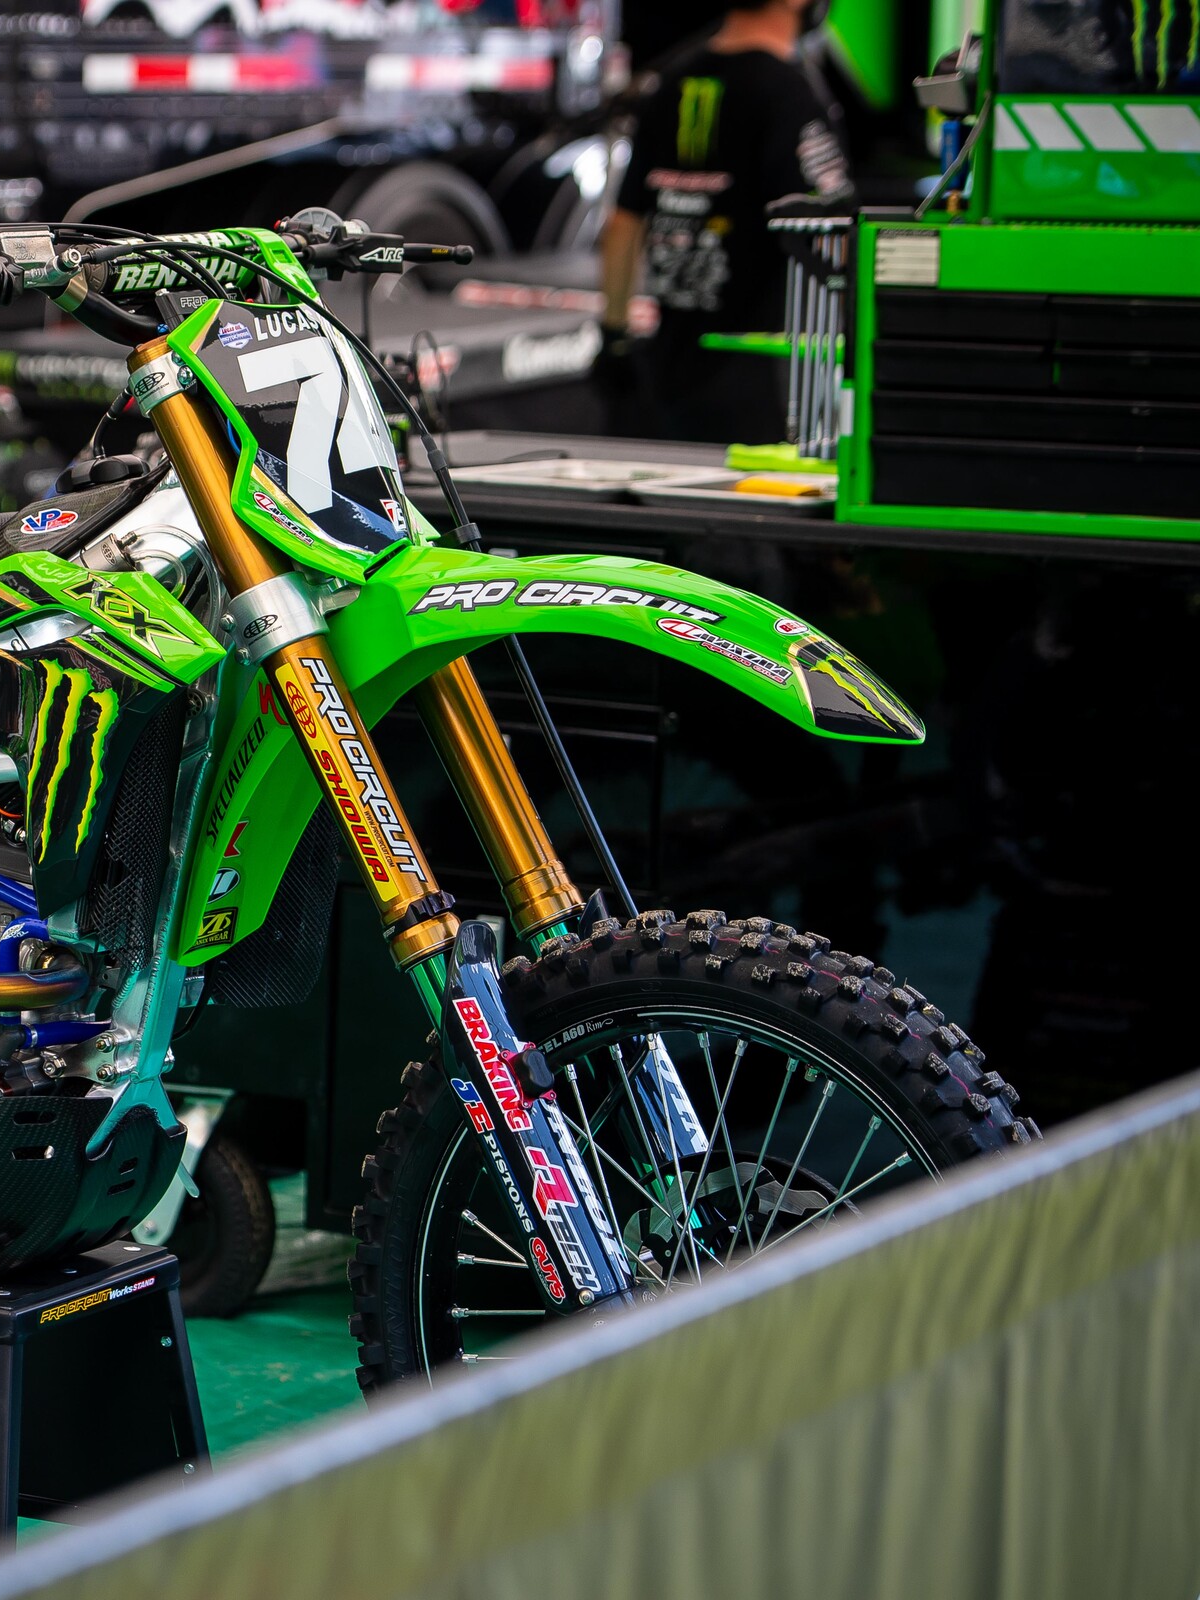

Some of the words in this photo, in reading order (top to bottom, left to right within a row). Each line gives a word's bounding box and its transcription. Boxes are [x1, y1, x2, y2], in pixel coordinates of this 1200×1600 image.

[359, 246, 404, 263] ARC
[22, 508, 62, 532] VP
[408, 580, 520, 614] PRO
[514, 582, 727, 624] CIRCUIT
[701, 641, 752, 667] RACING
[752, 664, 787, 684] OILS
[205, 716, 268, 848] SPECIALIZED
[299, 657, 358, 739] PRO
[339, 738, 427, 884] CIRCUIT
[314, 748, 391, 884] SHOWA
[363, 809, 396, 869] WWW.PROCIRCUIT.COM
[452, 997, 533, 1132] BRAKING
[561, 1026, 586, 1044] A60
[450, 1077, 495, 1134] JE
[482, 1132, 536, 1233] PISTONS
[531, 1236, 566, 1300] GUTS
[39, 1308, 68, 1325] PRO
[64, 1287, 113, 1314] CIRCUIT
